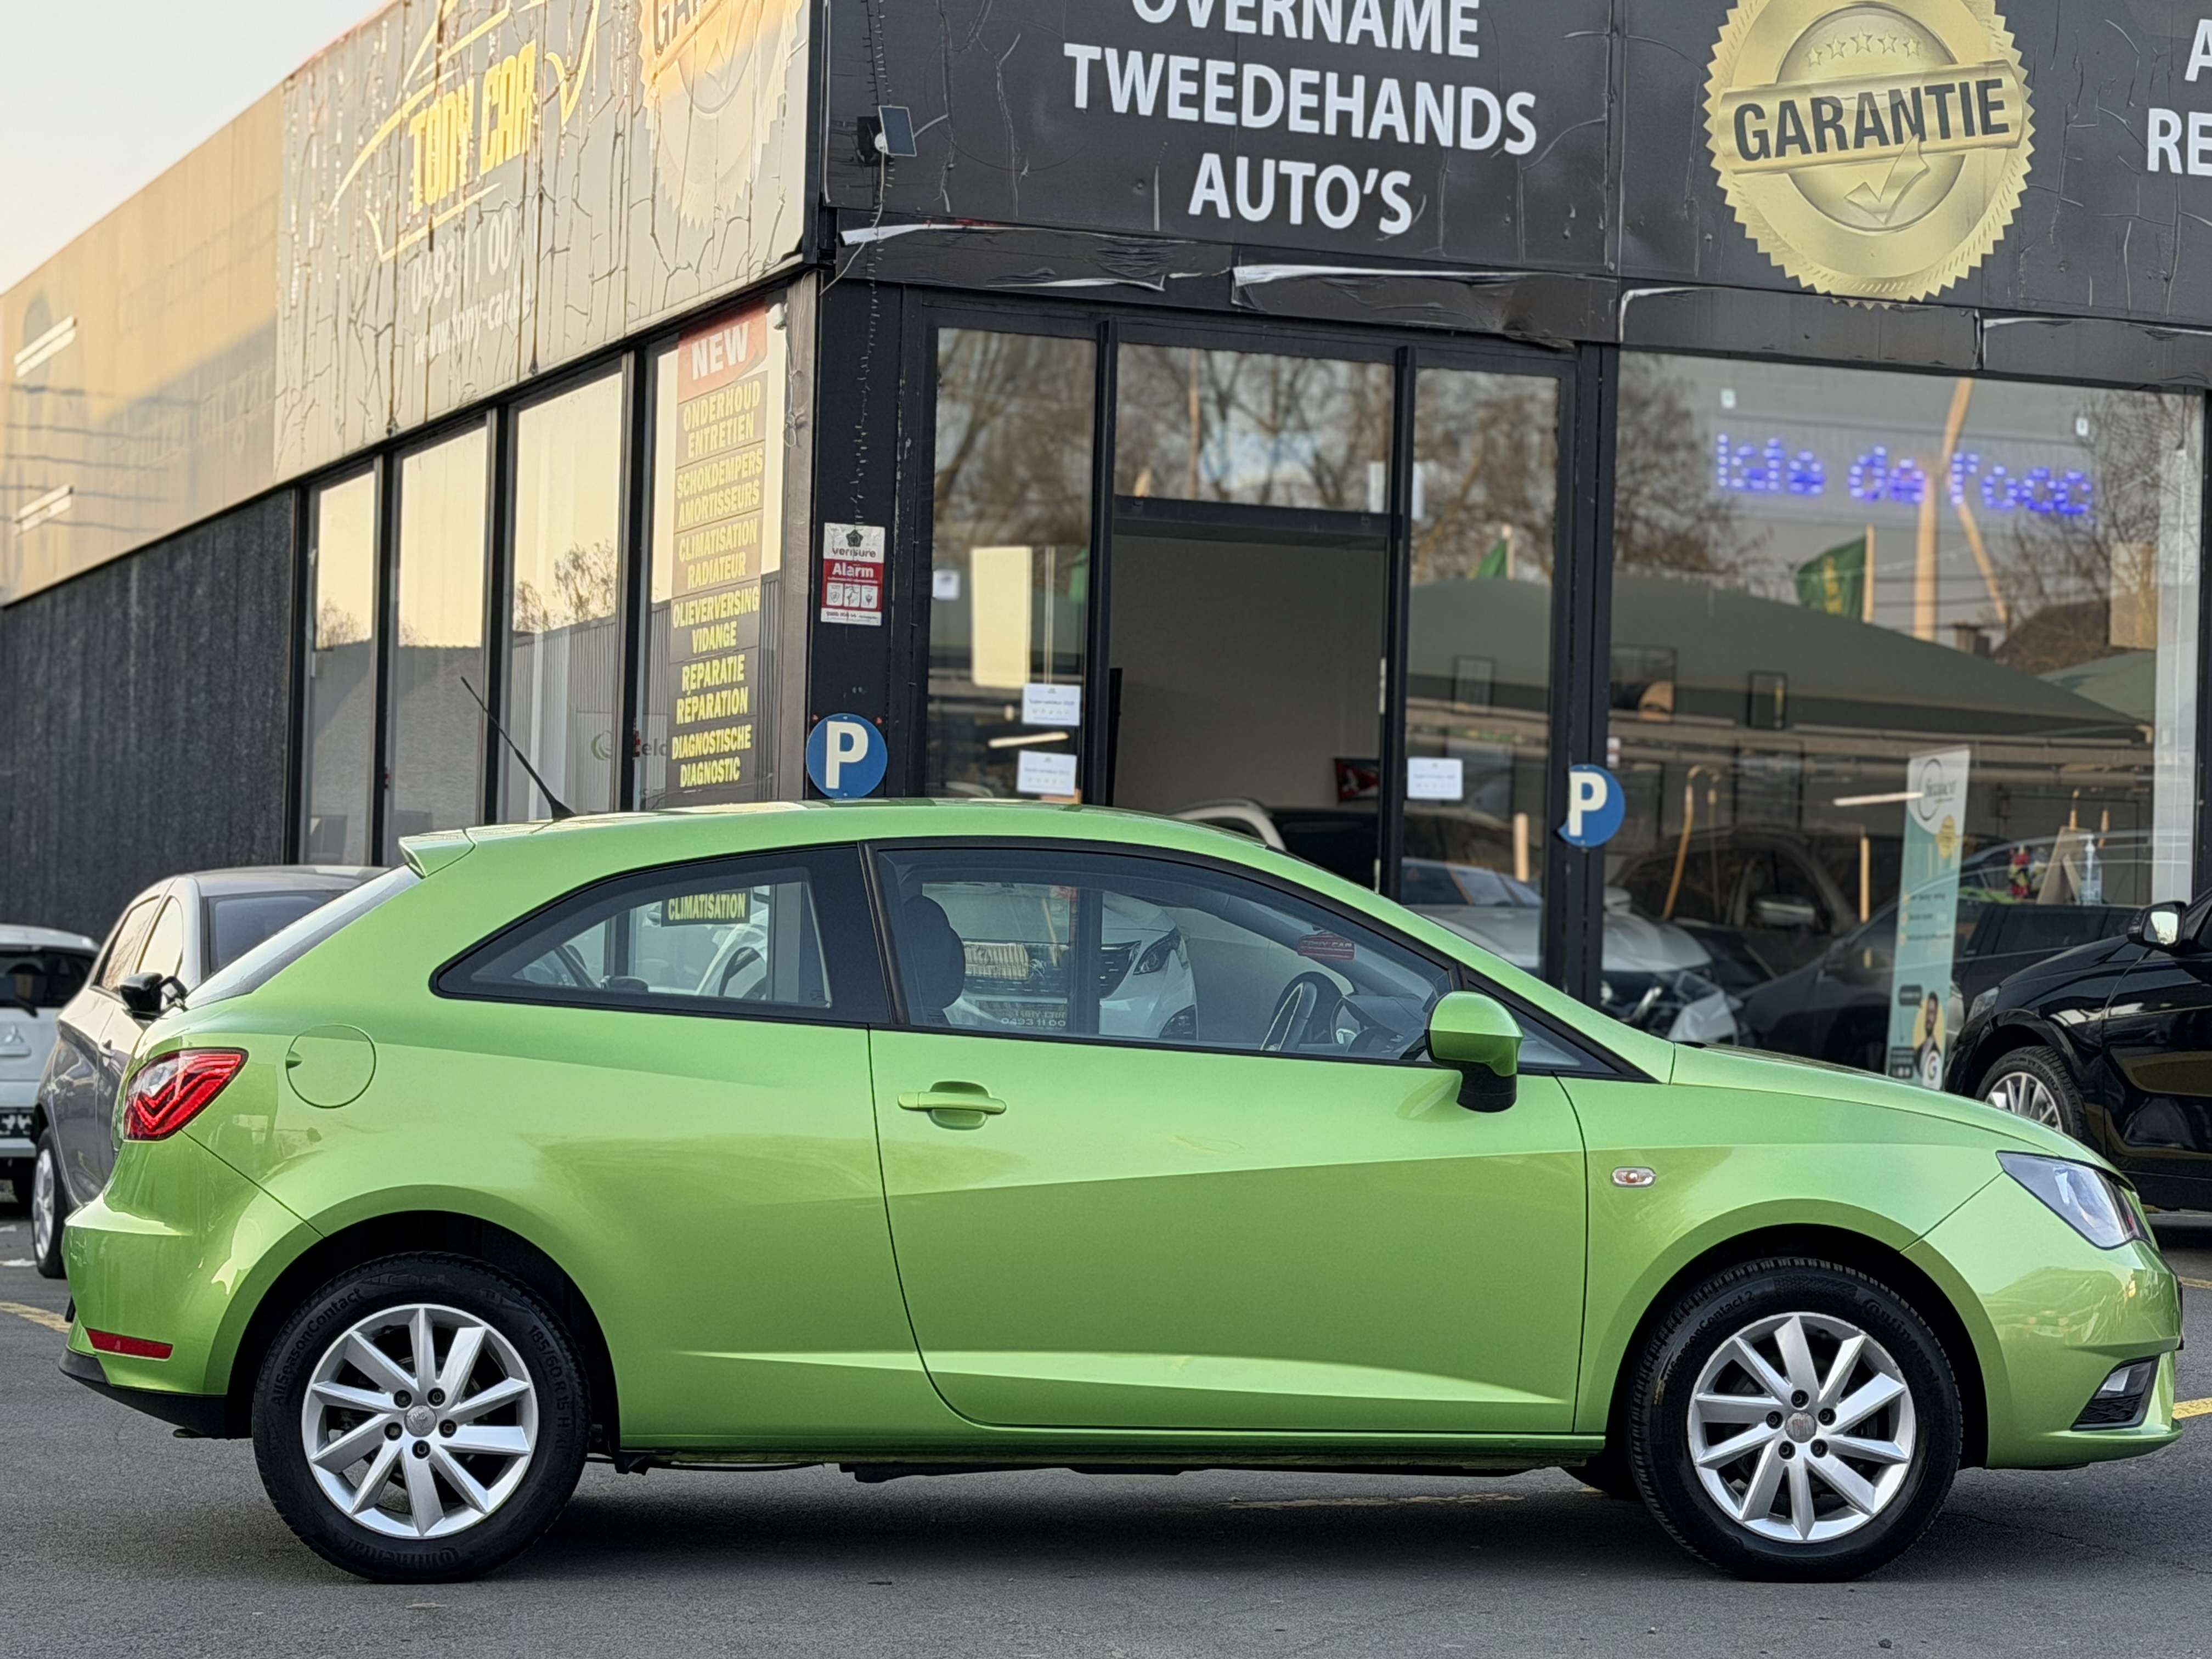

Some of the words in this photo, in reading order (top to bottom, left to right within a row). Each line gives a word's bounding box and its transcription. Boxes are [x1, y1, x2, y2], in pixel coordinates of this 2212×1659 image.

[1064, 42, 1537, 155] TWEEDEHANDS
[1734, 78, 2010, 162] GARANTIE
[408, 76, 475, 215] TONY
[479, 39, 536, 176] CAR
[1188, 153, 1413, 235] AUTO'S
[691, 321, 749, 381] NEW
[684, 380, 760, 432] ONDERHOUD
[688, 411, 754, 459] ENTRETIEN
[676, 448, 763, 499] SCHOKDEMPERS
[678, 479, 759, 528] AMORTISSEURS
[679, 518, 757, 563] CLIMATISATION
[687, 552, 746, 590] RADIATEUR
[832, 562, 874, 578] Alarm
[673, 586, 760, 628] OLIEVERVERSING
[692, 621, 737, 654] VIDANGE
[682, 654, 745, 691] REPARATIE
[672, 724, 752, 759] DIAGNOSTISCHE
[826, 721, 868, 789] P
[680, 757, 740, 788] DIAGNOSTIC
[1568, 771, 1607, 837] P
[668, 893, 746, 921] CLIMATISATION
[271, 1287, 365, 1406] AllSeasonContact
